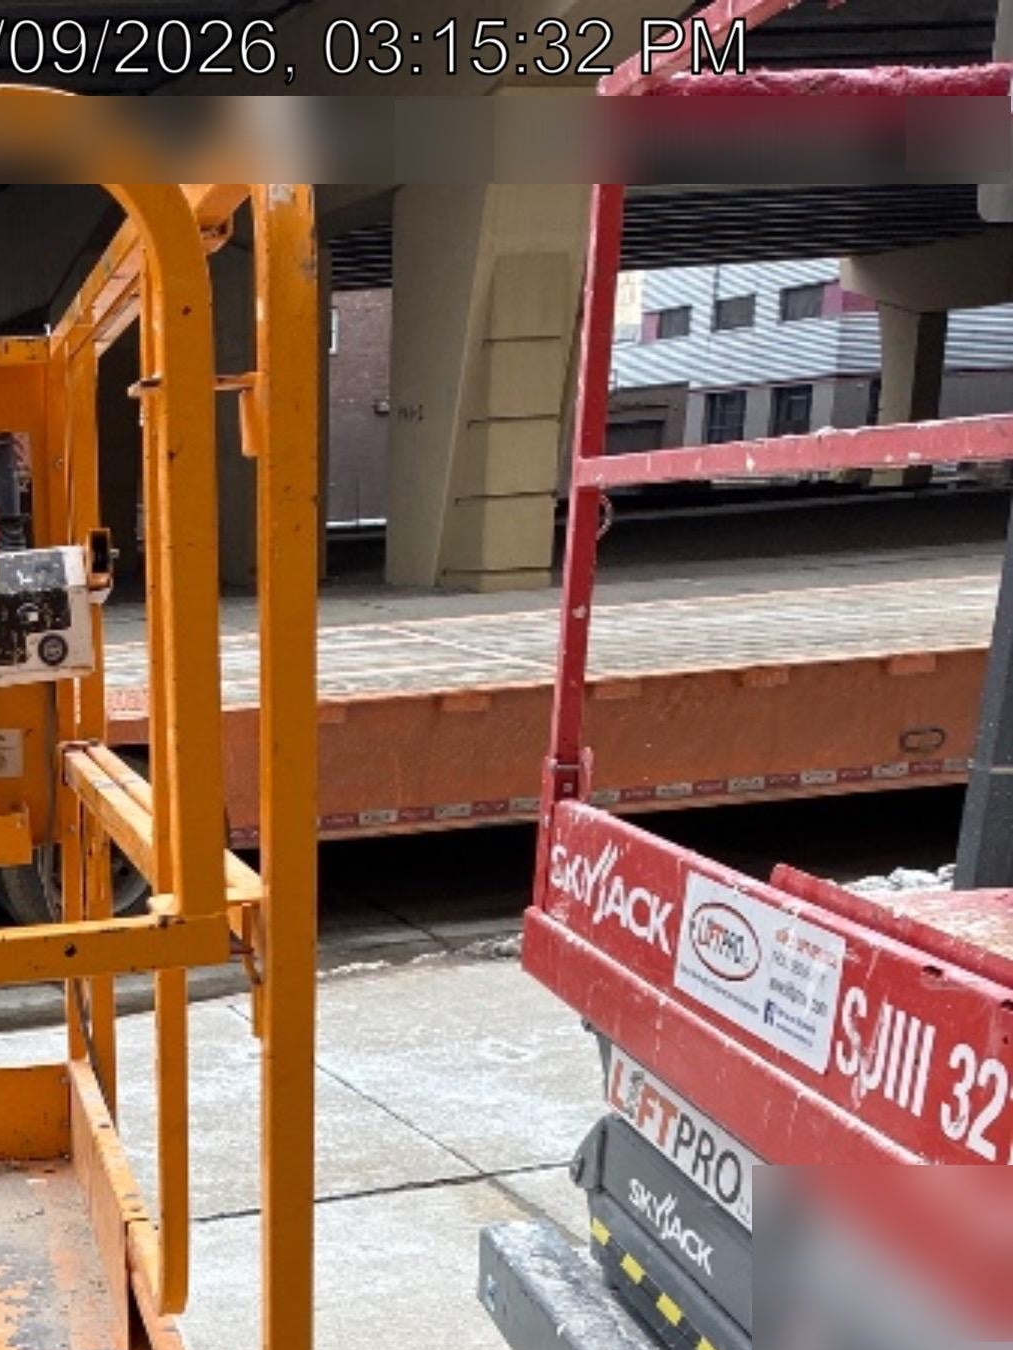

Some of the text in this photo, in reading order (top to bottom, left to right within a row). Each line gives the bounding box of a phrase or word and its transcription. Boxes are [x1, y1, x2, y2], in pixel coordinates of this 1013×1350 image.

[550, 839, 673, 956] SKYJACK
[941, 1042, 1013, 1166] 32
[628, 1178, 715, 1277] SKYJACK
